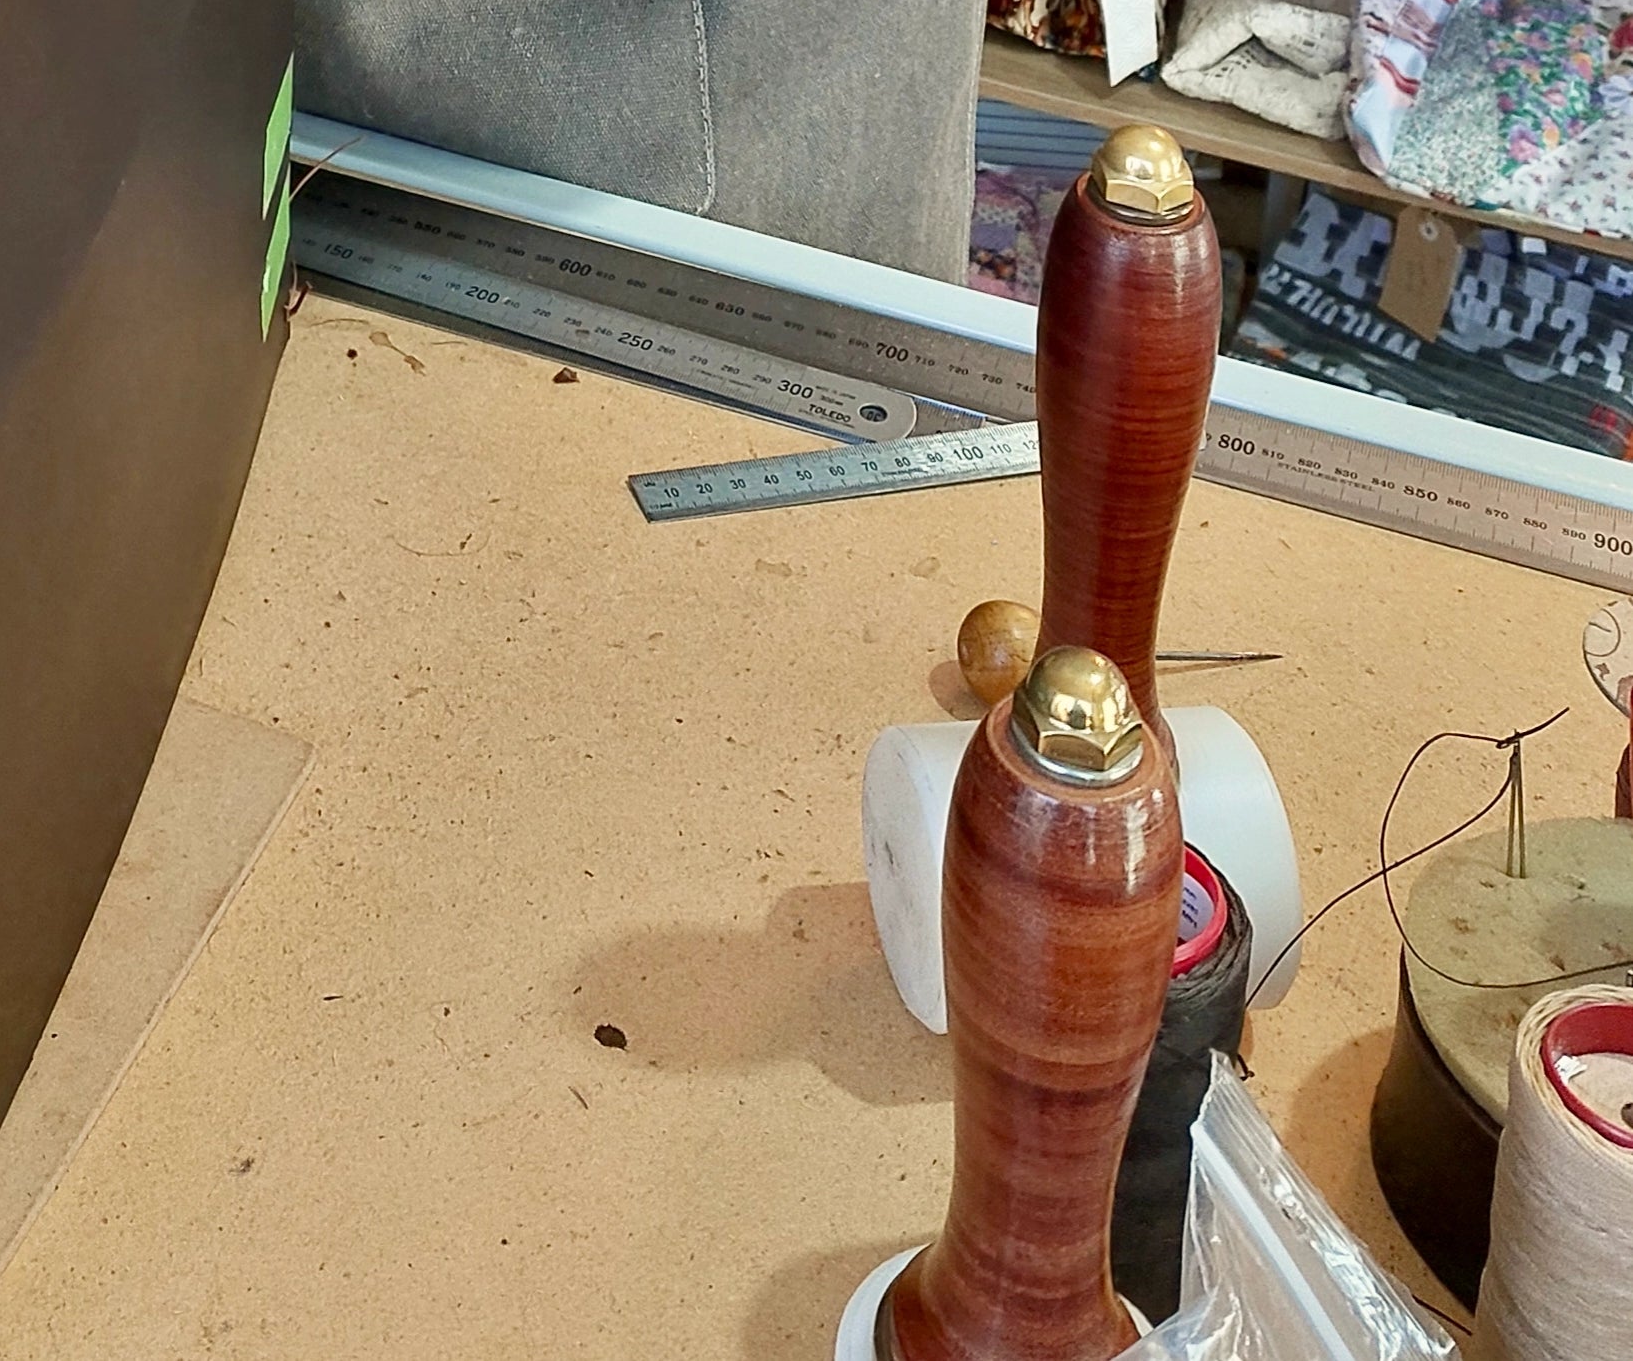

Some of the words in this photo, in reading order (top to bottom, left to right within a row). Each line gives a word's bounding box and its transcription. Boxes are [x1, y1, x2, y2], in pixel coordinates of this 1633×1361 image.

[324, 243, 355, 260] 150
[464, 285, 500, 304] 200
[532, 307, 552, 318] 220
[563, 316, 582, 327] 230
[593, 326, 613, 336] 240
[617, 331, 653, 351] 250
[657, 344, 677, 356] 260
[689, 354, 709, 366] 270
[720, 364, 740, 375] 280
[752, 373, 772, 385] 290
[777, 379, 814, 399] 300
[558, 258, 592, 277] 600
[715, 301, 745, 317] 650
[875, 342, 909, 362] 700
[915, 355, 936, 367] 710
[948, 363, 969, 376] 720
[981, 373, 1003, 385] 730
[664, 487, 679, 499] 10
[696, 483, 713, 494] 20
[730, 478, 747, 490] 30
[763, 474, 780, 485] 40
[796, 470, 813, 482] 50
[828, 465, 845, 477] 60
[860, 461, 878, 472] 70
[894, 456, 911, 468] 80
[927, 452, 944, 463] 90
[953, 446, 984, 461] 100
[990, 443, 1012, 455] 110
[1023, 440, 1039, 451] 12
[809, 403, 852, 423] TOLEDO
[1217, 433, 1255, 456] 800
[1261, 447, 1285, 461] 810
[1297, 457, 1322, 470] 820
[1334, 467, 1358, 480] 830
[1370, 477, 1396, 490] 840
[1402, 484, 1439, 502] 850
[1446, 496, 1471, 510] 860
[1484, 507, 1510, 520] 870
[1523, 517, 1548, 530] 880
[1561, 527, 1587, 541] 890
[1593, 533, 1633, 556] 900
